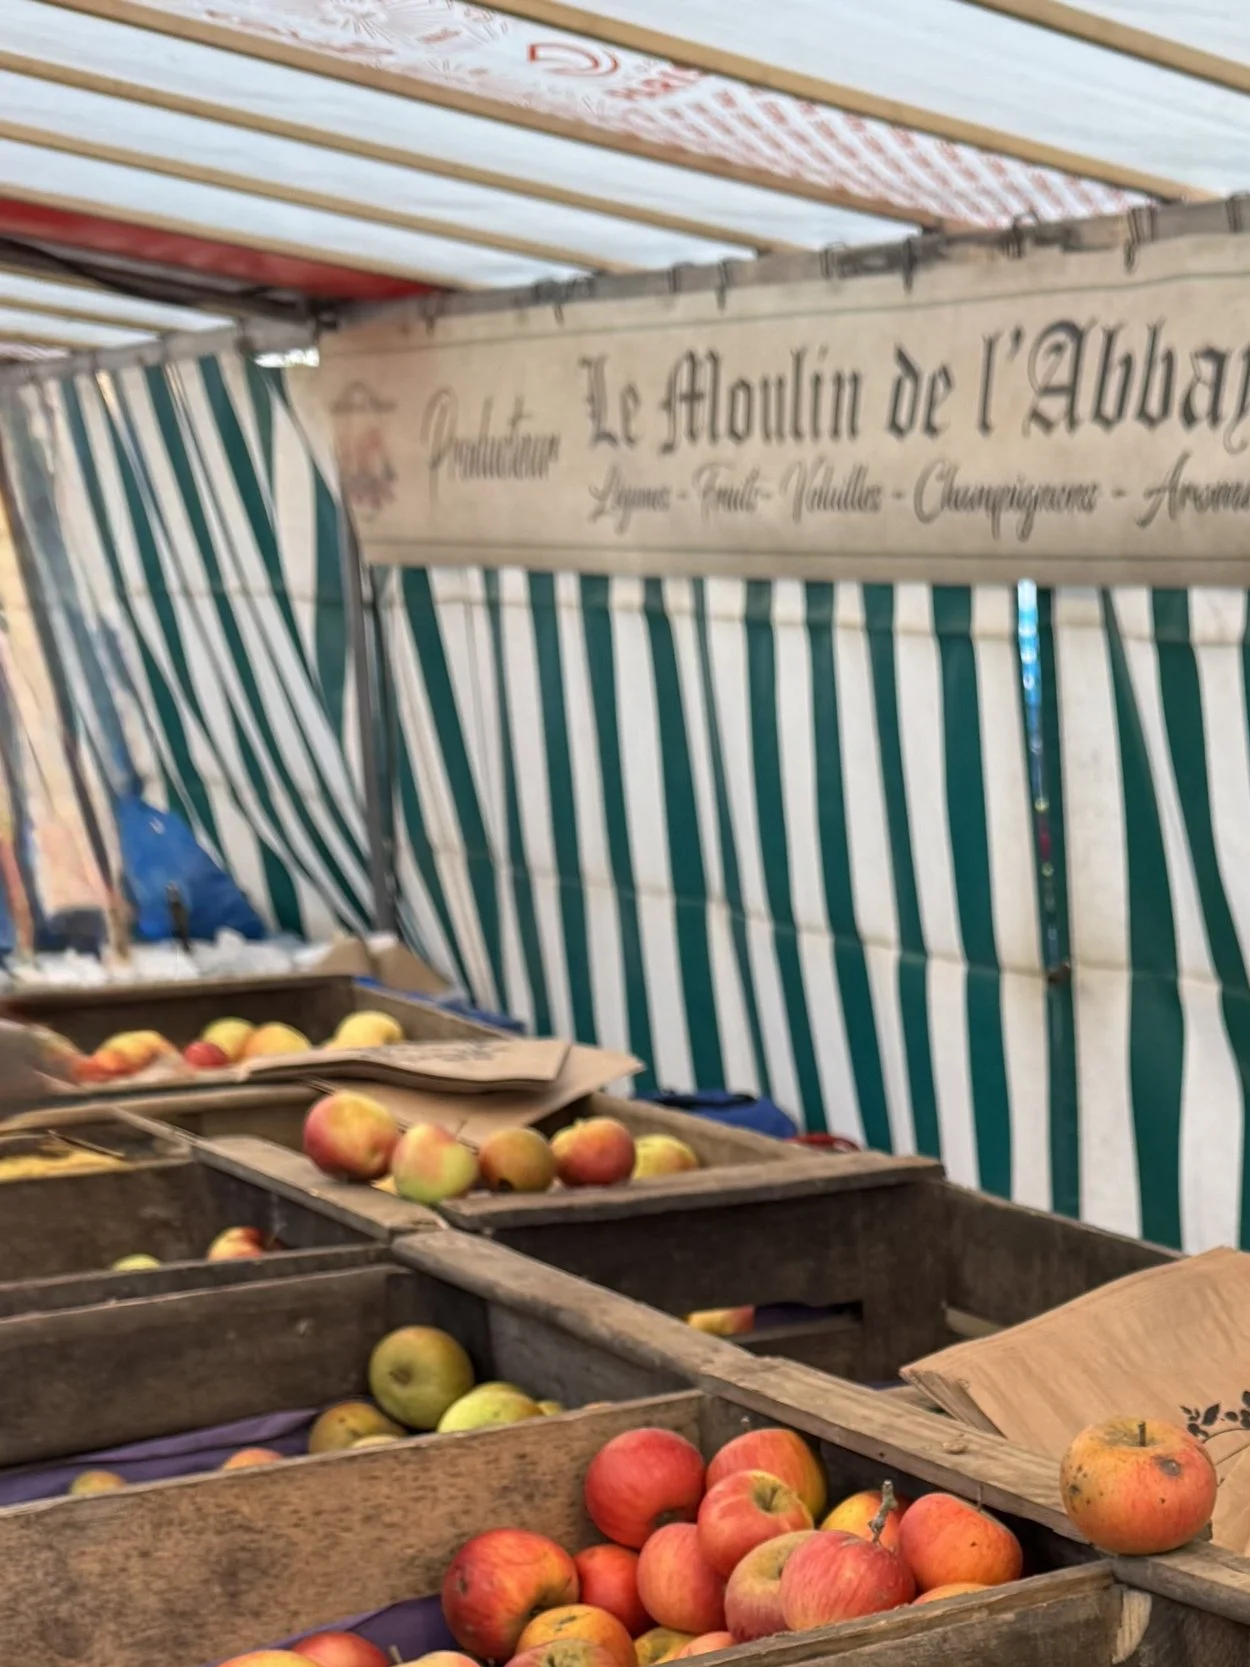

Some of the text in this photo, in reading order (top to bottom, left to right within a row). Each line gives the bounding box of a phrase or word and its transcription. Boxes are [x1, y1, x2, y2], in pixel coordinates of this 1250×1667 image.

[578, 352, 640, 450] Le
[657, 347, 862, 454] Moulin
[885, 344, 954, 440] de
